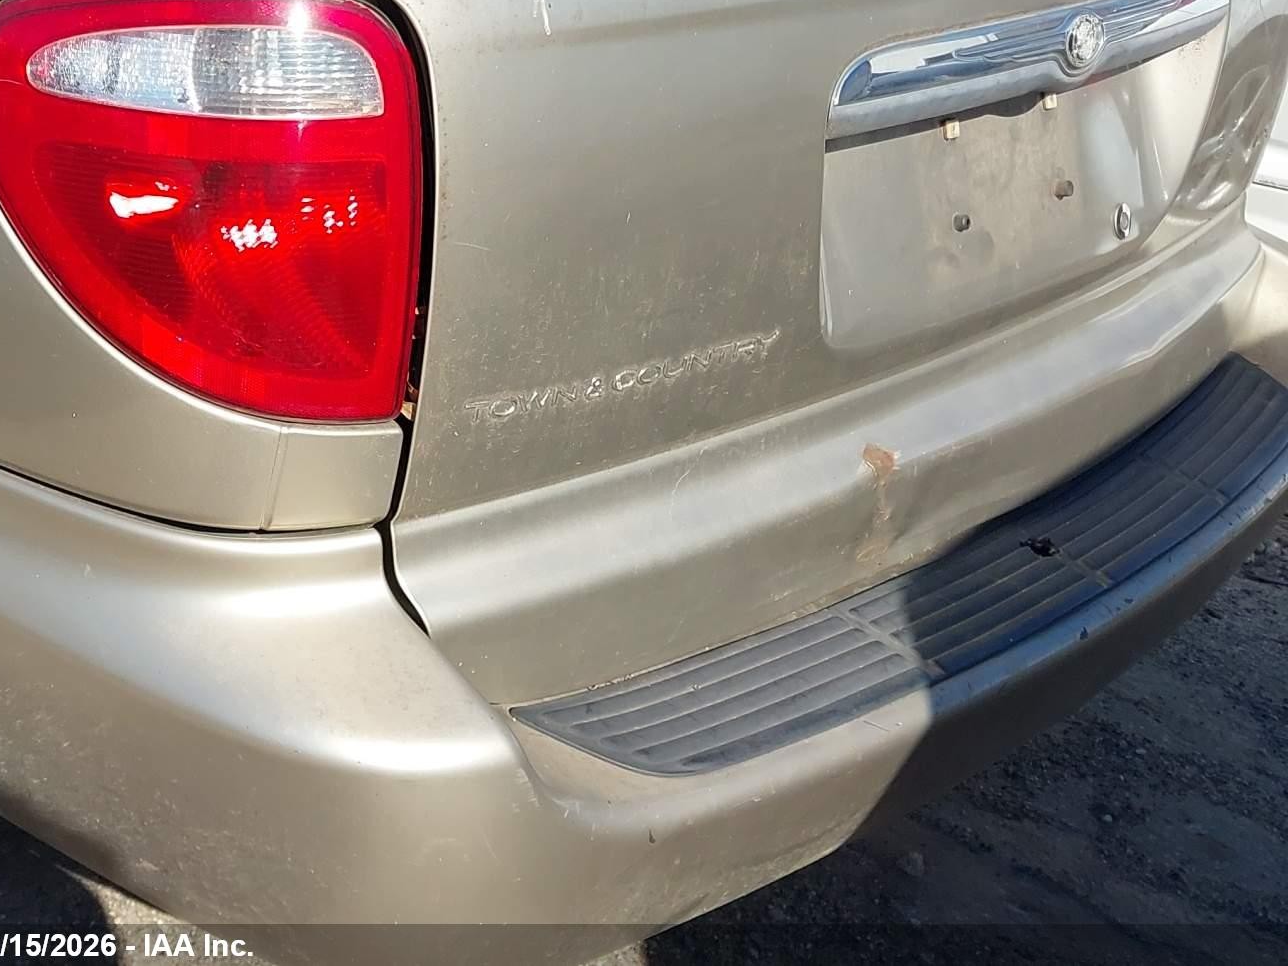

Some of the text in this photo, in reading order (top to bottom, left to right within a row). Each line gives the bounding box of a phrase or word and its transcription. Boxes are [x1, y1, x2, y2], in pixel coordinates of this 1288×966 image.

[464, 329, 781, 423] TOWN & COUNTRY
